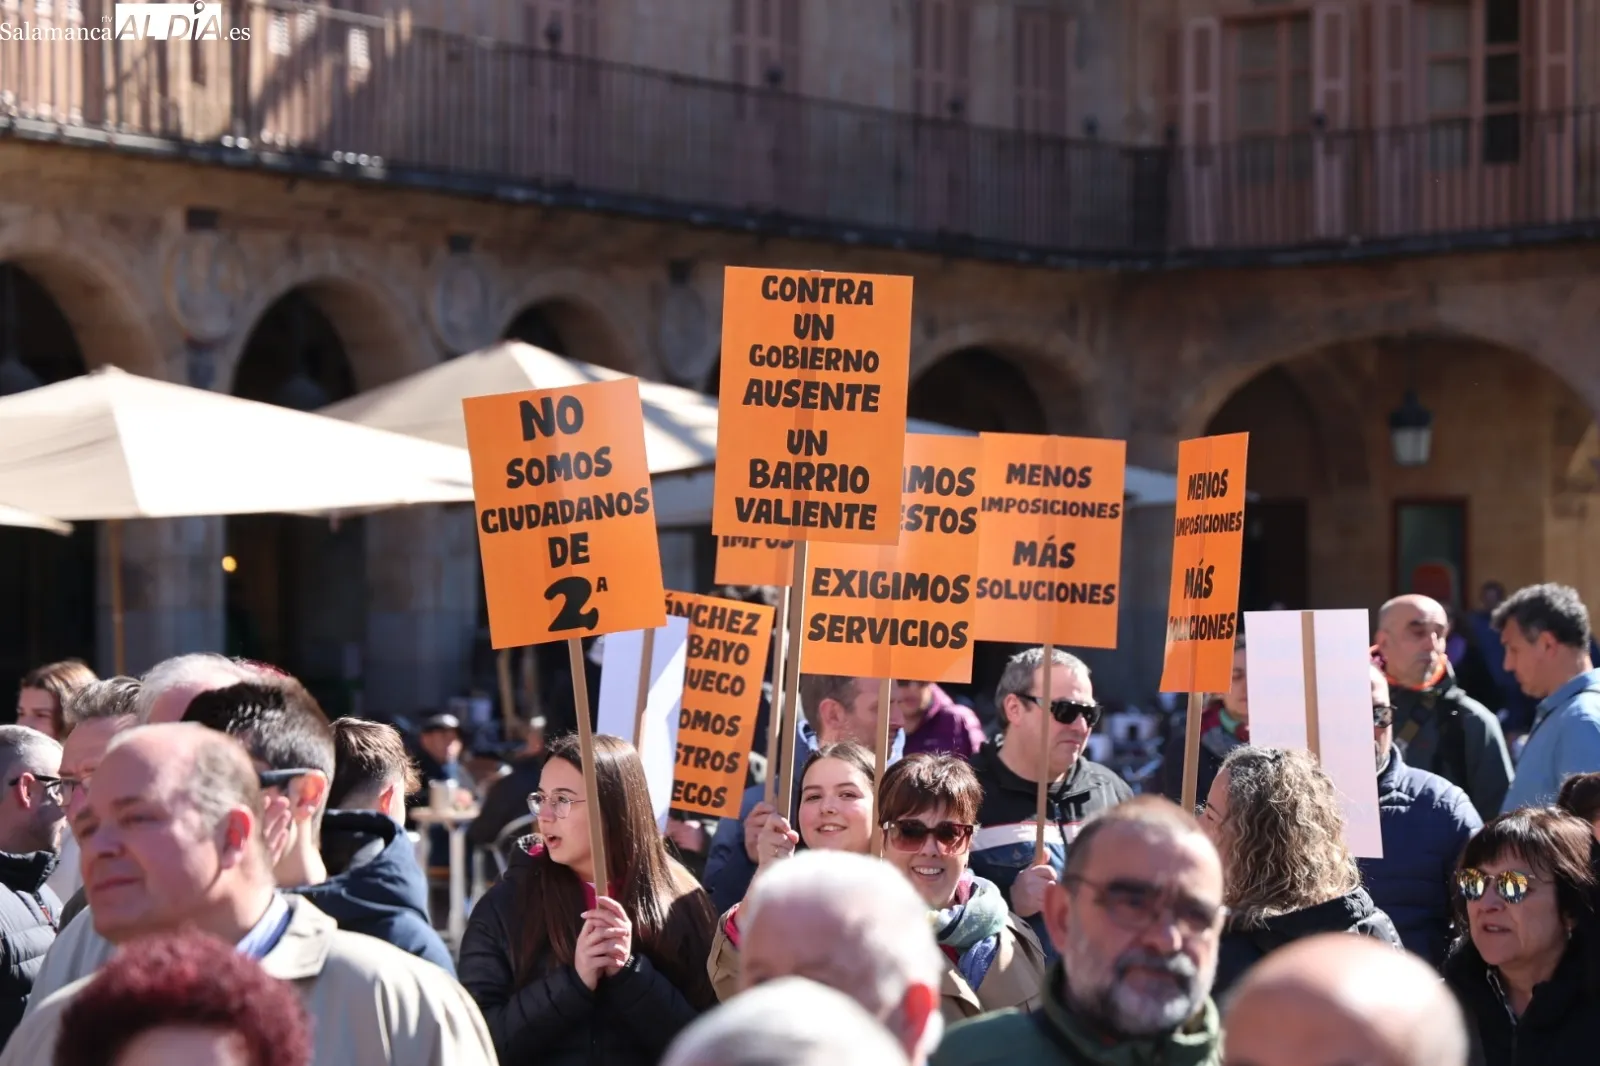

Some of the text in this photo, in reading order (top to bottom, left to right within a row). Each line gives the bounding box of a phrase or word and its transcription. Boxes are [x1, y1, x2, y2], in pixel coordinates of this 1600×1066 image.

[761, 275, 874, 305] CONTRA
[793, 313, 834, 341] UN
[749, 344, 880, 373] GOBIERNO
[742, 378, 881, 412] AUSENTE
[519, 395, 584, 441] NO
[787, 429, 828, 456] UN
[506, 446, 612, 489] SOMOS
[749, 458, 870, 494] BARRIO
[1005, 462, 1093, 489] MENOS
[1186, 468, 1229, 501] MENOS
[480, 487, 650, 533] CIUDADANOS
[735, 496, 877, 531] VALIENTE
[900, 503, 978, 535] STOS
[980, 496, 1121, 519] IMPOSICIONES
[1175, 510, 1243, 537] IMPOSICIONES
[548, 532, 590, 568] DE
[1012, 535, 1076, 569] MÁS
[811, 567, 971, 603] EXIGIMOS
[976, 577, 1117, 605] SOLUCIONES
[1183, 558, 1215, 600] MÁS
[807, 612, 969, 649] SERVICIOS
[687, 633, 750, 666] BAYO
[679, 708, 742, 737] OMOS
